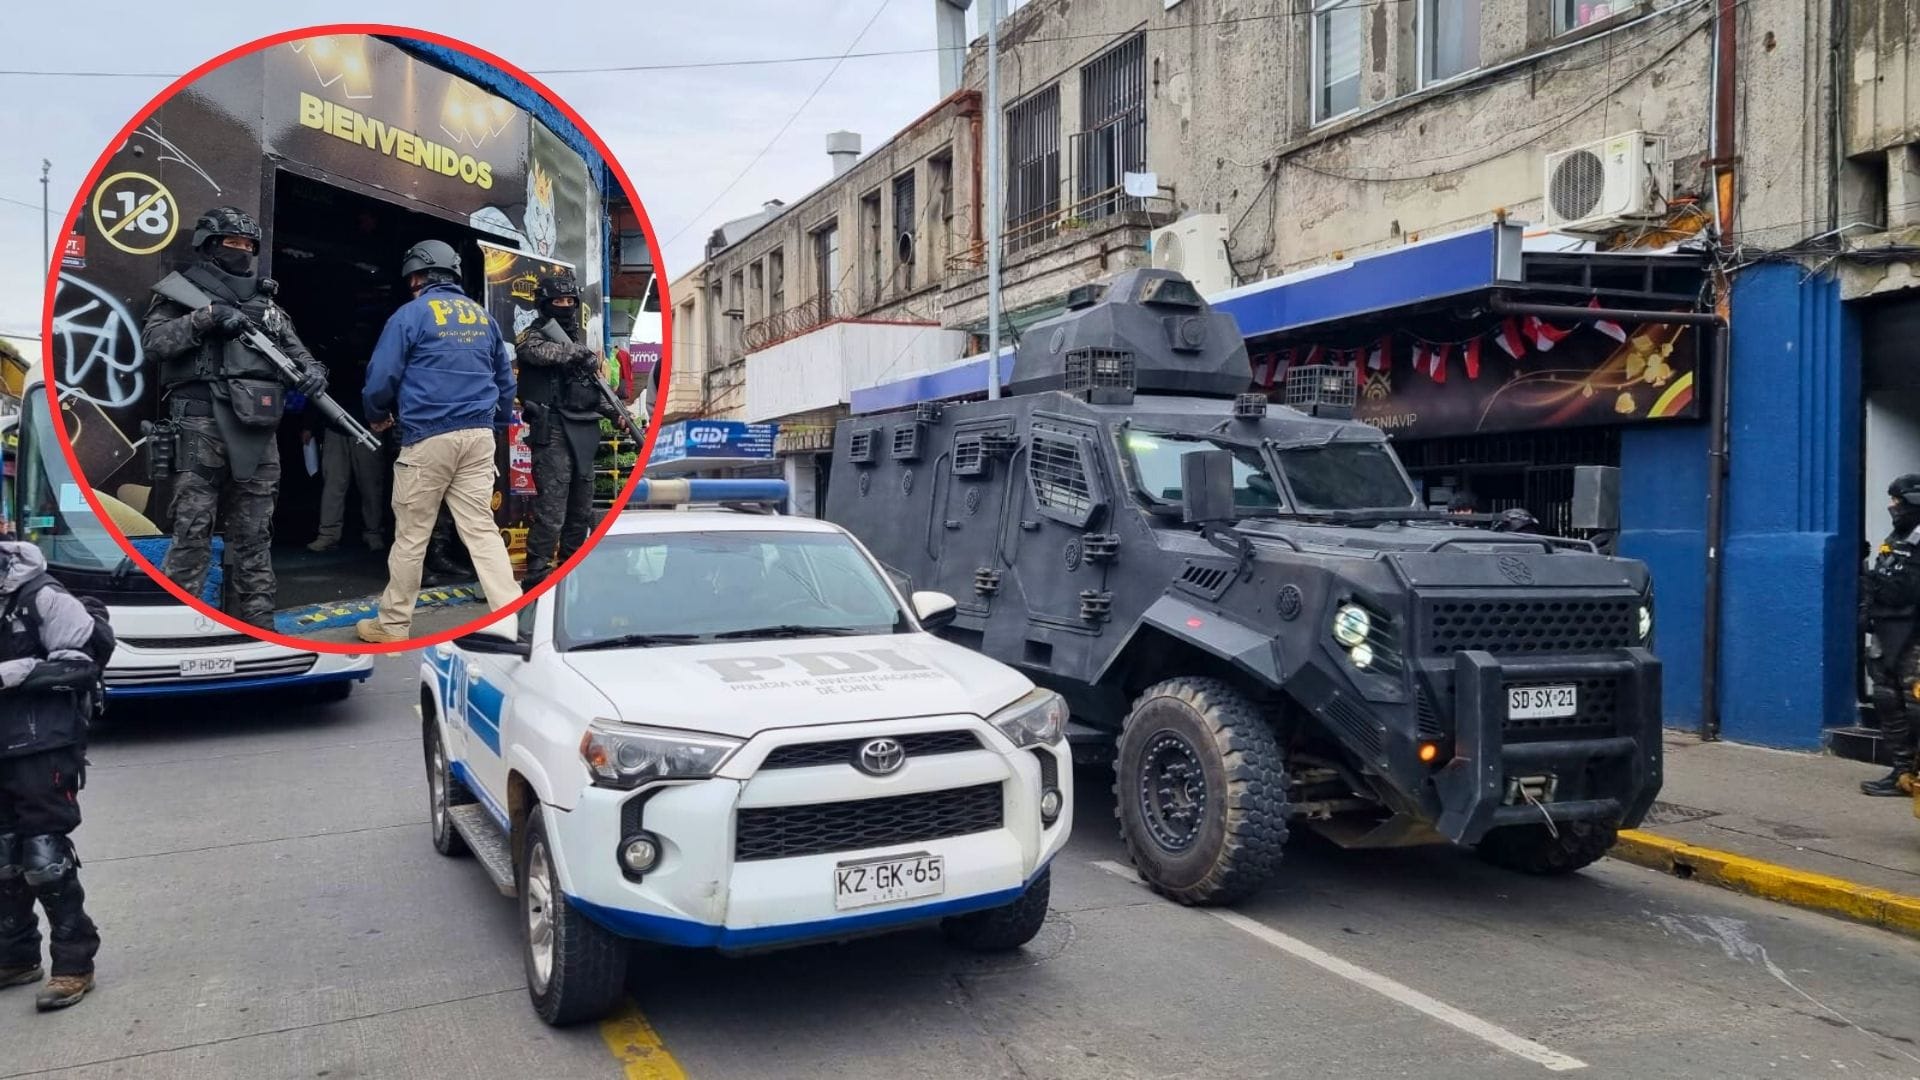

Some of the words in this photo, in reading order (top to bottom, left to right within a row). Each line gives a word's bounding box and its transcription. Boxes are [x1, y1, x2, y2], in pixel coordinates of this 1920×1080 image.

[300, 91, 494, 190] BIENVENIDOS
[696, 649, 932, 683] PDI
[793, 679, 813, 687] DE
[816, 671, 945, 687] INVESTIGACIONES
[816, 686, 837, 696] DE
[840, 682, 885, 693] CHILE
